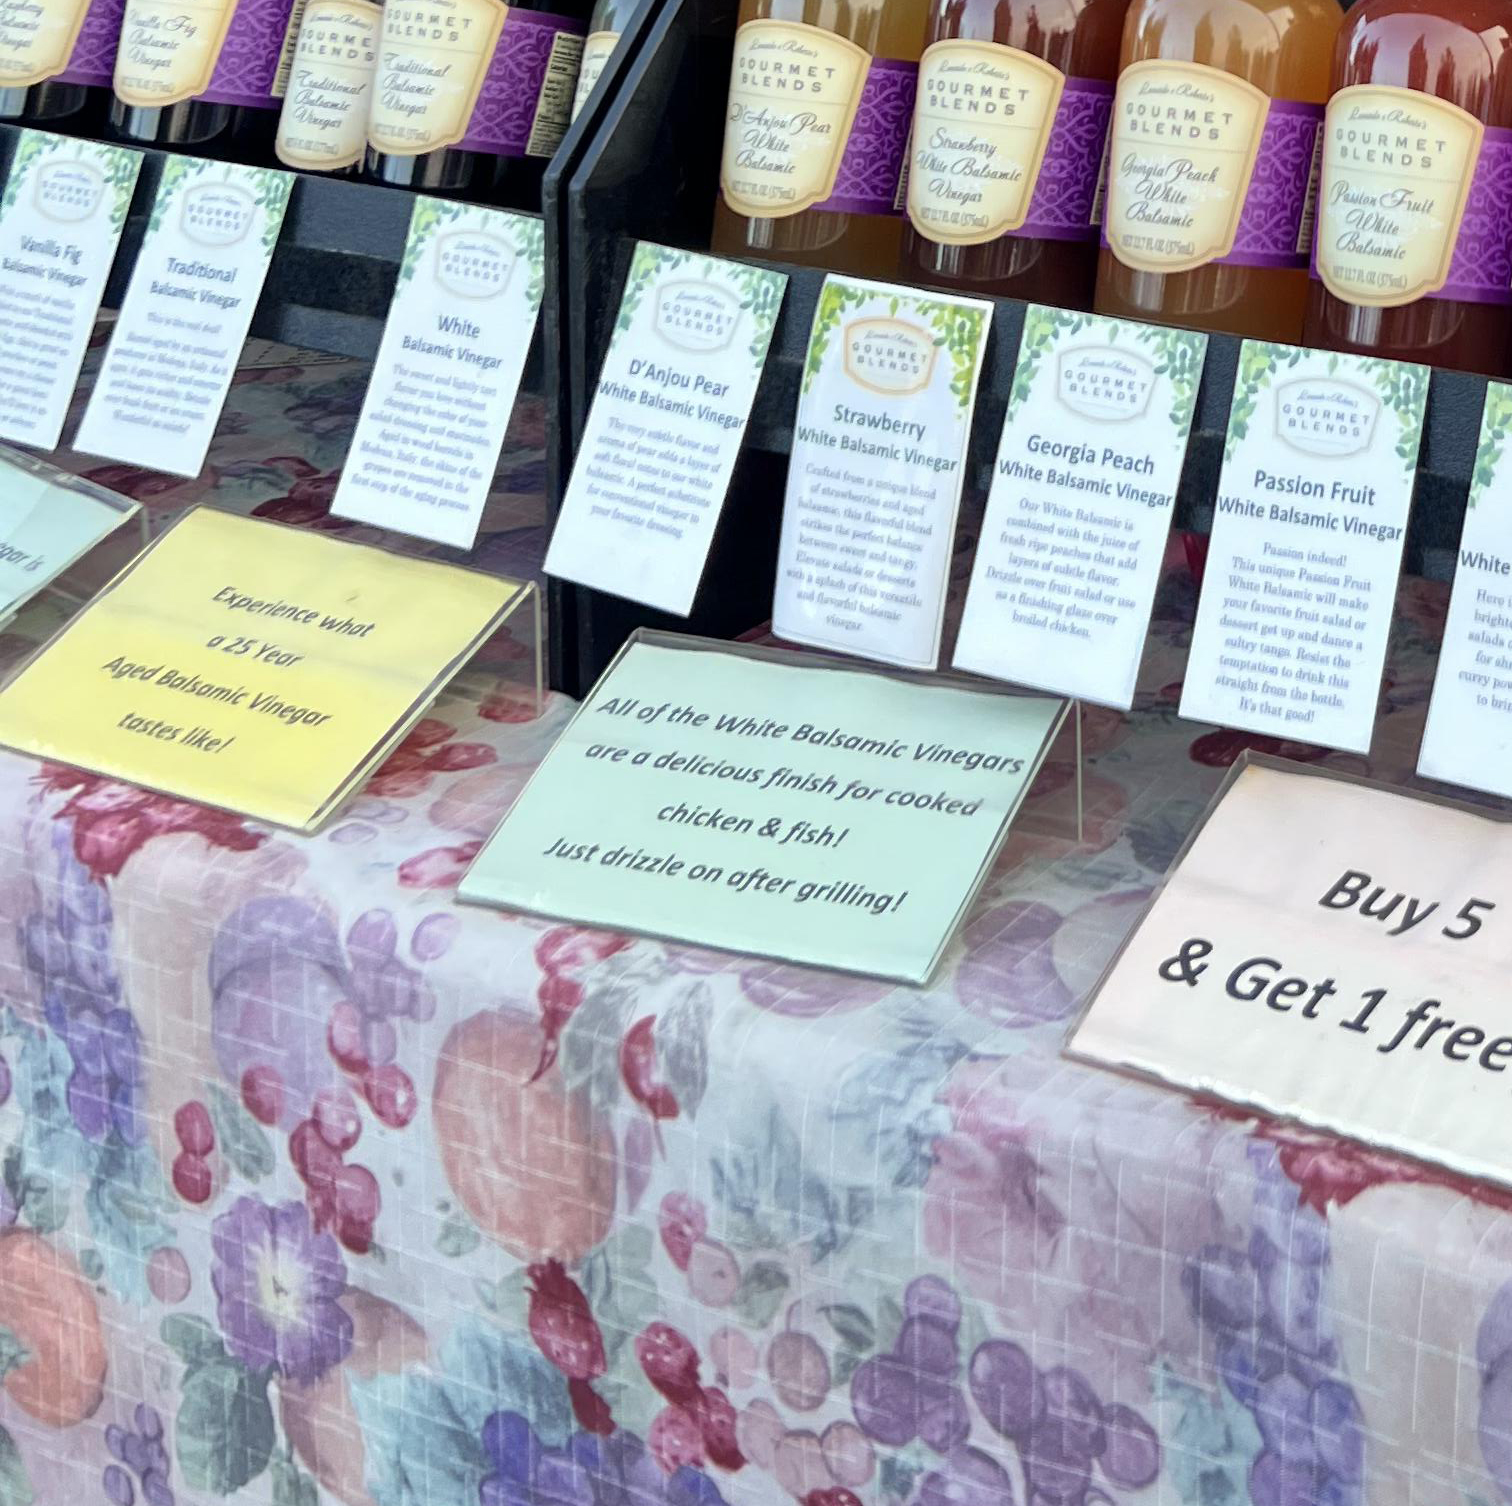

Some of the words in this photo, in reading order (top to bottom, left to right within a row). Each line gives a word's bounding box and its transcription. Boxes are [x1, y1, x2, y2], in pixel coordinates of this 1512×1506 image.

[166, 257, 238, 283] Traditional
[437, 313, 480, 338] White
[401, 334, 454, 359] Balsamic
[456, 346, 503, 370] Vinegar
[627, 358, 691, 388] D'Anjou
[692, 374, 729, 398] Pear
[833, 403, 926, 442] Strawberry
[1026, 433, 1096, 465] Georgia
[1100, 447, 1154, 475] Peach
[1253, 469, 1324, 498] Passion
[1330, 481, 1376, 506] Fruit
[1460, 549, 1510, 575] White
[211, 585, 320, 624] Experience
[317, 614, 375, 637] what
[205, 635, 227, 648] a
[221, 636, 259, 655] 25
[251, 642, 305, 667] Year
[101, 655, 163, 681] Aged
[154, 668, 250, 705] Balsamic
[247, 691, 333, 727] Vinegar
[116, 711, 184, 741] tastes
[177, 725, 236, 753] like!
[595, 697, 640, 716] All
[635, 702, 672, 724] of
[665, 705, 710, 727] the
[713, 713, 789, 738] White
[790, 723, 908, 758] Balsamic
[912, 742, 1025, 774] Vinegars
[584, 743, 629, 762] are
[630, 751, 652, 765] a
[652, 750, 765, 783] delicious
[758, 766, 838, 794] finish
[833, 779, 884, 801] for
[884, 790, 984, 816] cooked
[656, 801, 754, 833] chicken
[756, 817, 782, 838] &
[777, 820, 850, 848] fish!
[541, 836, 600, 863] Just
[599, 844, 685, 876] drizzle
[687, 864, 724, 882] on
[726, 867, 797, 894] after
[793, 880, 908, 914] grilling!
[1319, 869, 1440, 936] Buy
[1441, 898, 1496, 940] 5
[1158, 937, 1215, 987] &
[1225, 956, 1338, 1019] Get
[1340, 988, 1387, 1034] 1
